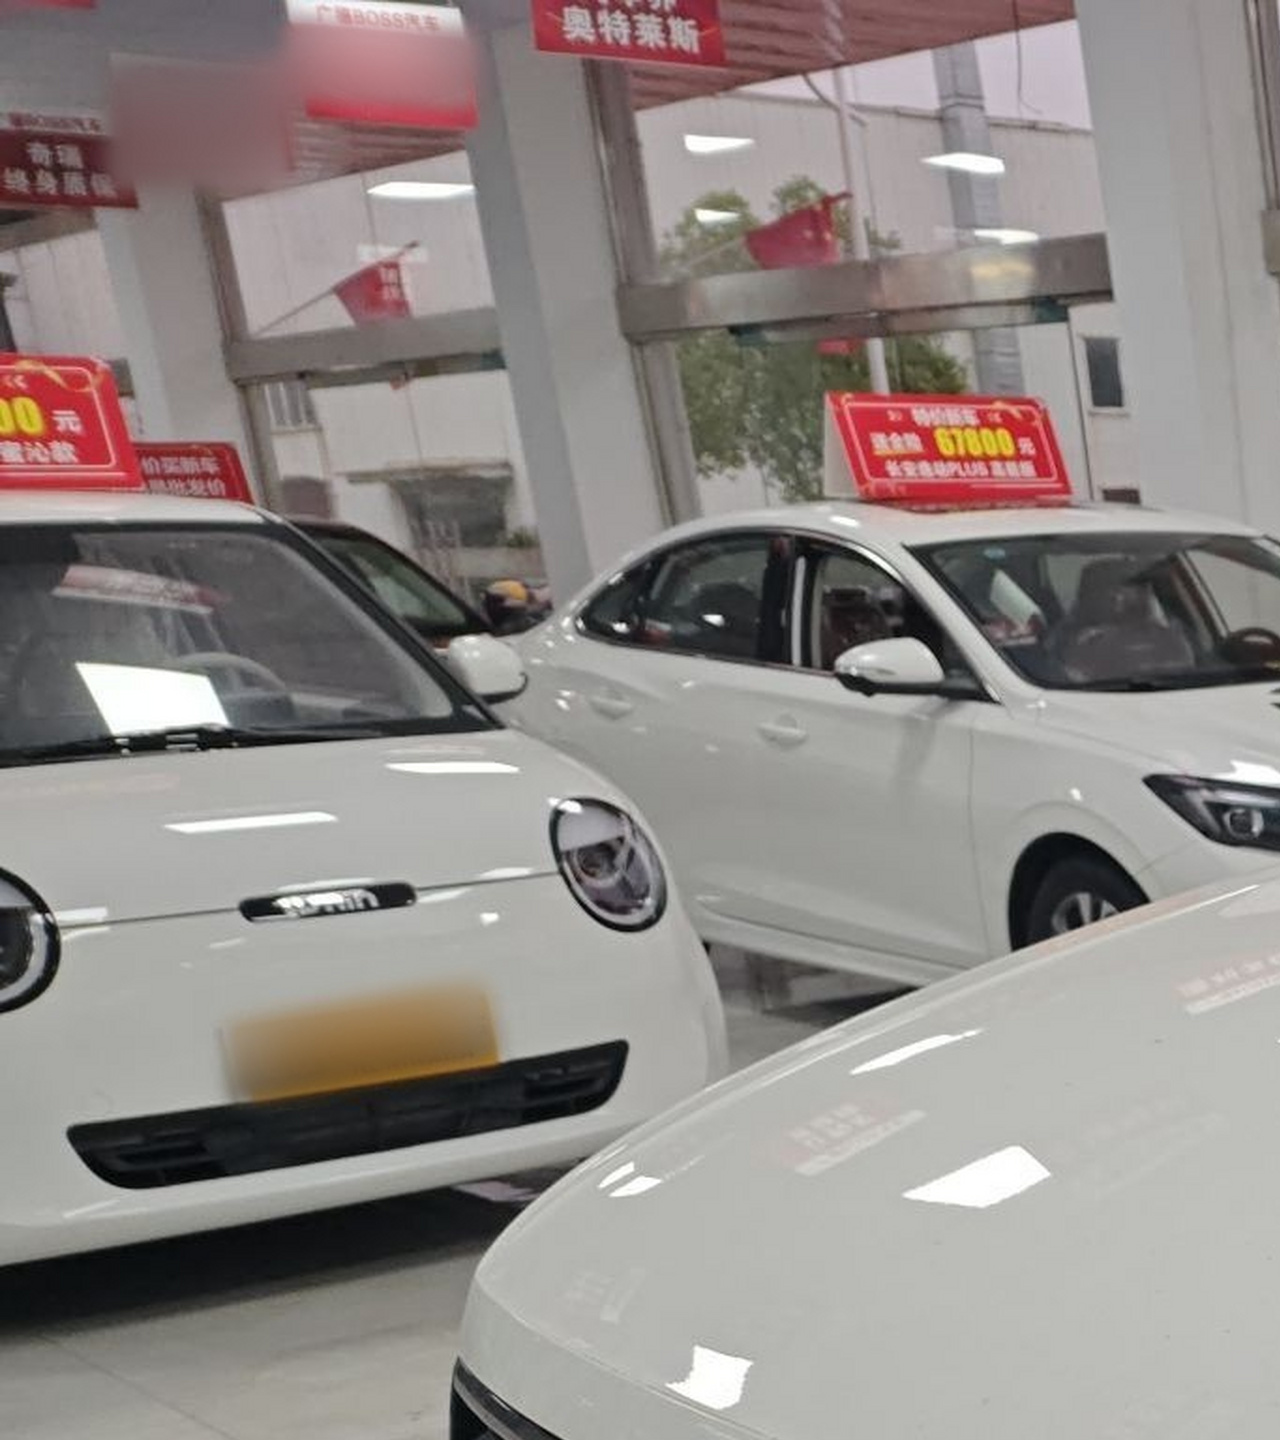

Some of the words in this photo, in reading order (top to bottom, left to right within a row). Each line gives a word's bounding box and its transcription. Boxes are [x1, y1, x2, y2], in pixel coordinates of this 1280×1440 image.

[563, 6, 699, 52] 奥特莱斯
[52, 410, 84, 433] 元
[934, 426, 1016, 459] 67800
